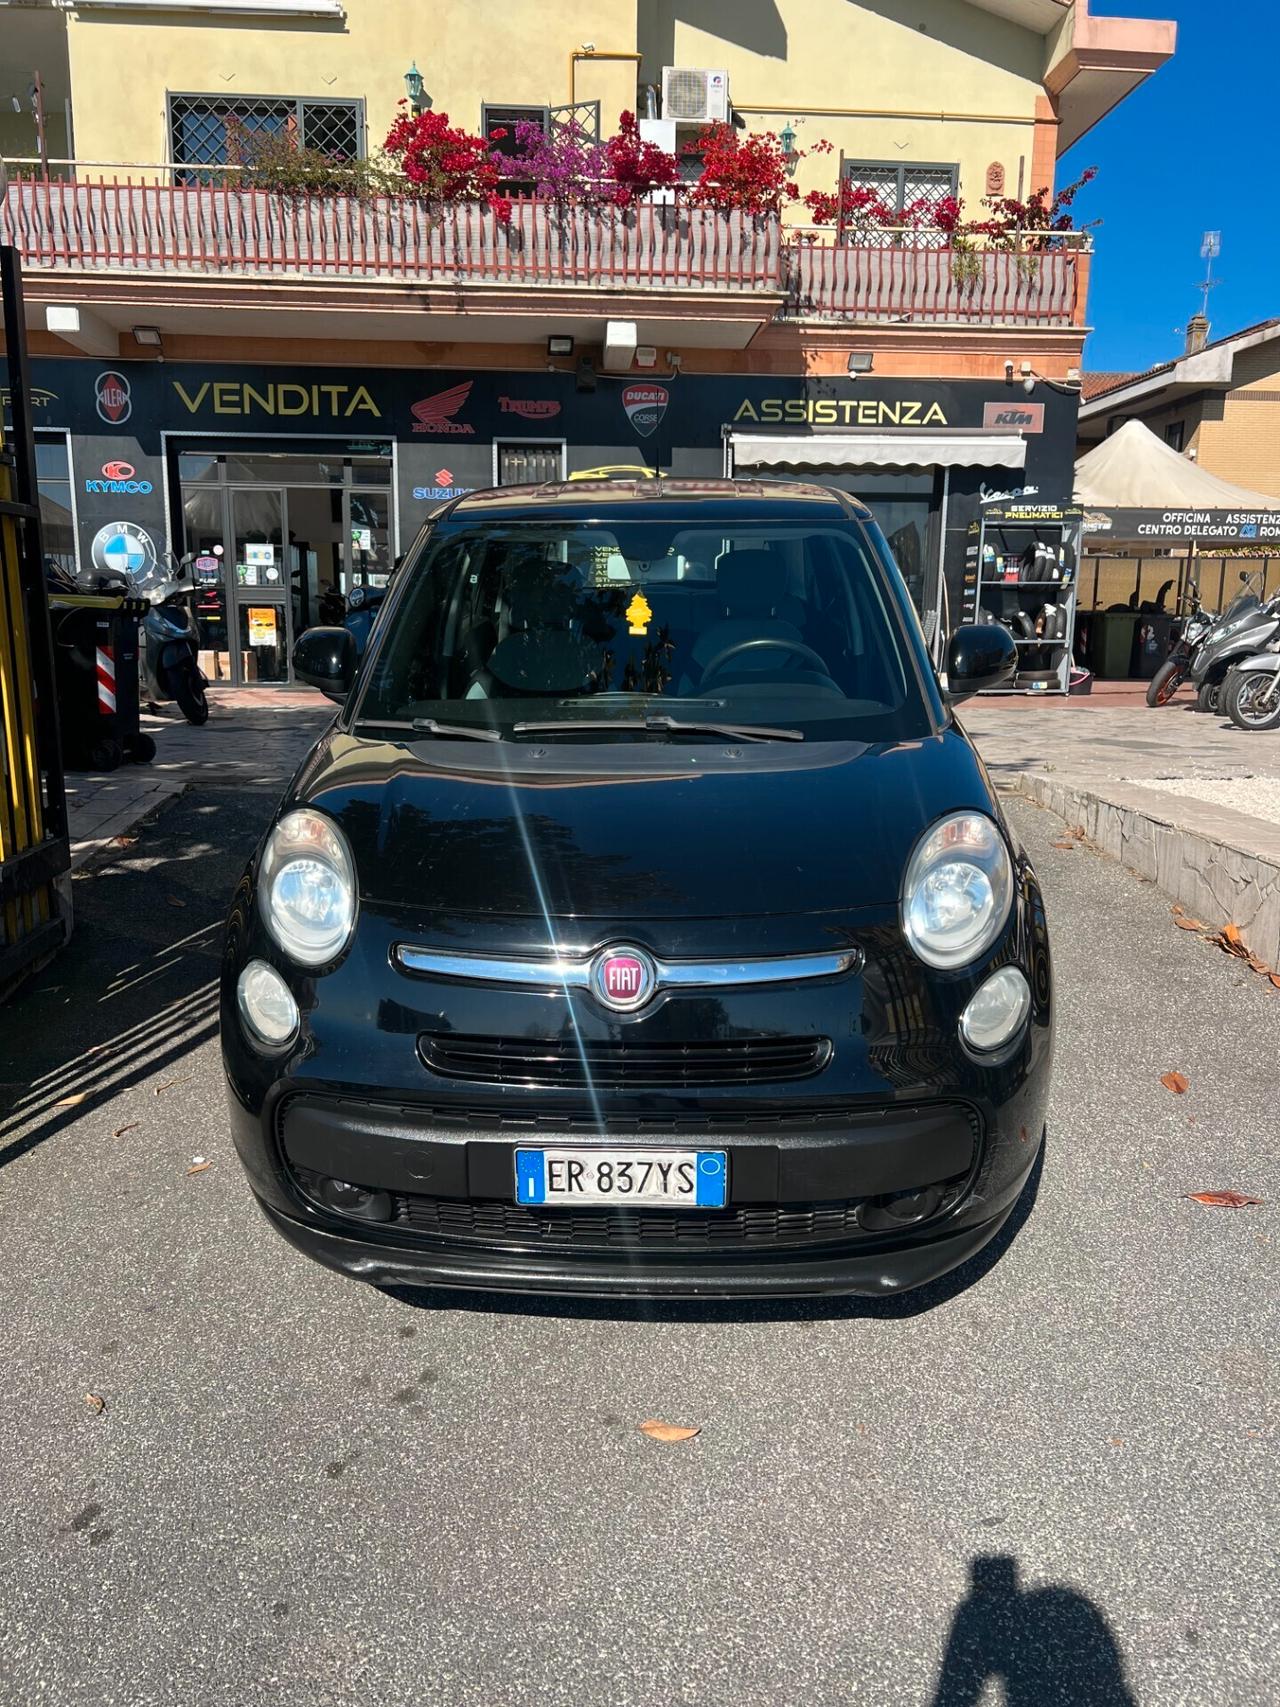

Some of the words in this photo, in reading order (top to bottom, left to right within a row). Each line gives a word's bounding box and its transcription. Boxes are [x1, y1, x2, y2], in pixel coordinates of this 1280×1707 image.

[173, 381, 382, 417] VENDITA
[626, 391, 665, 401] DUCATI
[633, 414, 658, 423] CORSE
[733, 398, 948, 425] ASSISTENZA
[994, 409, 1033, 425] KTM
[412, 422, 476, 434] HONDA
[85, 480, 153, 494] KYMCO
[1004, 511, 1064, 519] PNEUMATICI
[1162, 513, 1211, 523] OFFICINA
[98, 524, 149, 544] BMW
[1137, 524, 1182, 535] CENTRO
[1183, 525, 1238, 536] DELEGATO
[608, 967, 639, 991] FIAT
[548, 1160, 584, 1192] ER
[597, 1161, 695, 1193] 837YS
